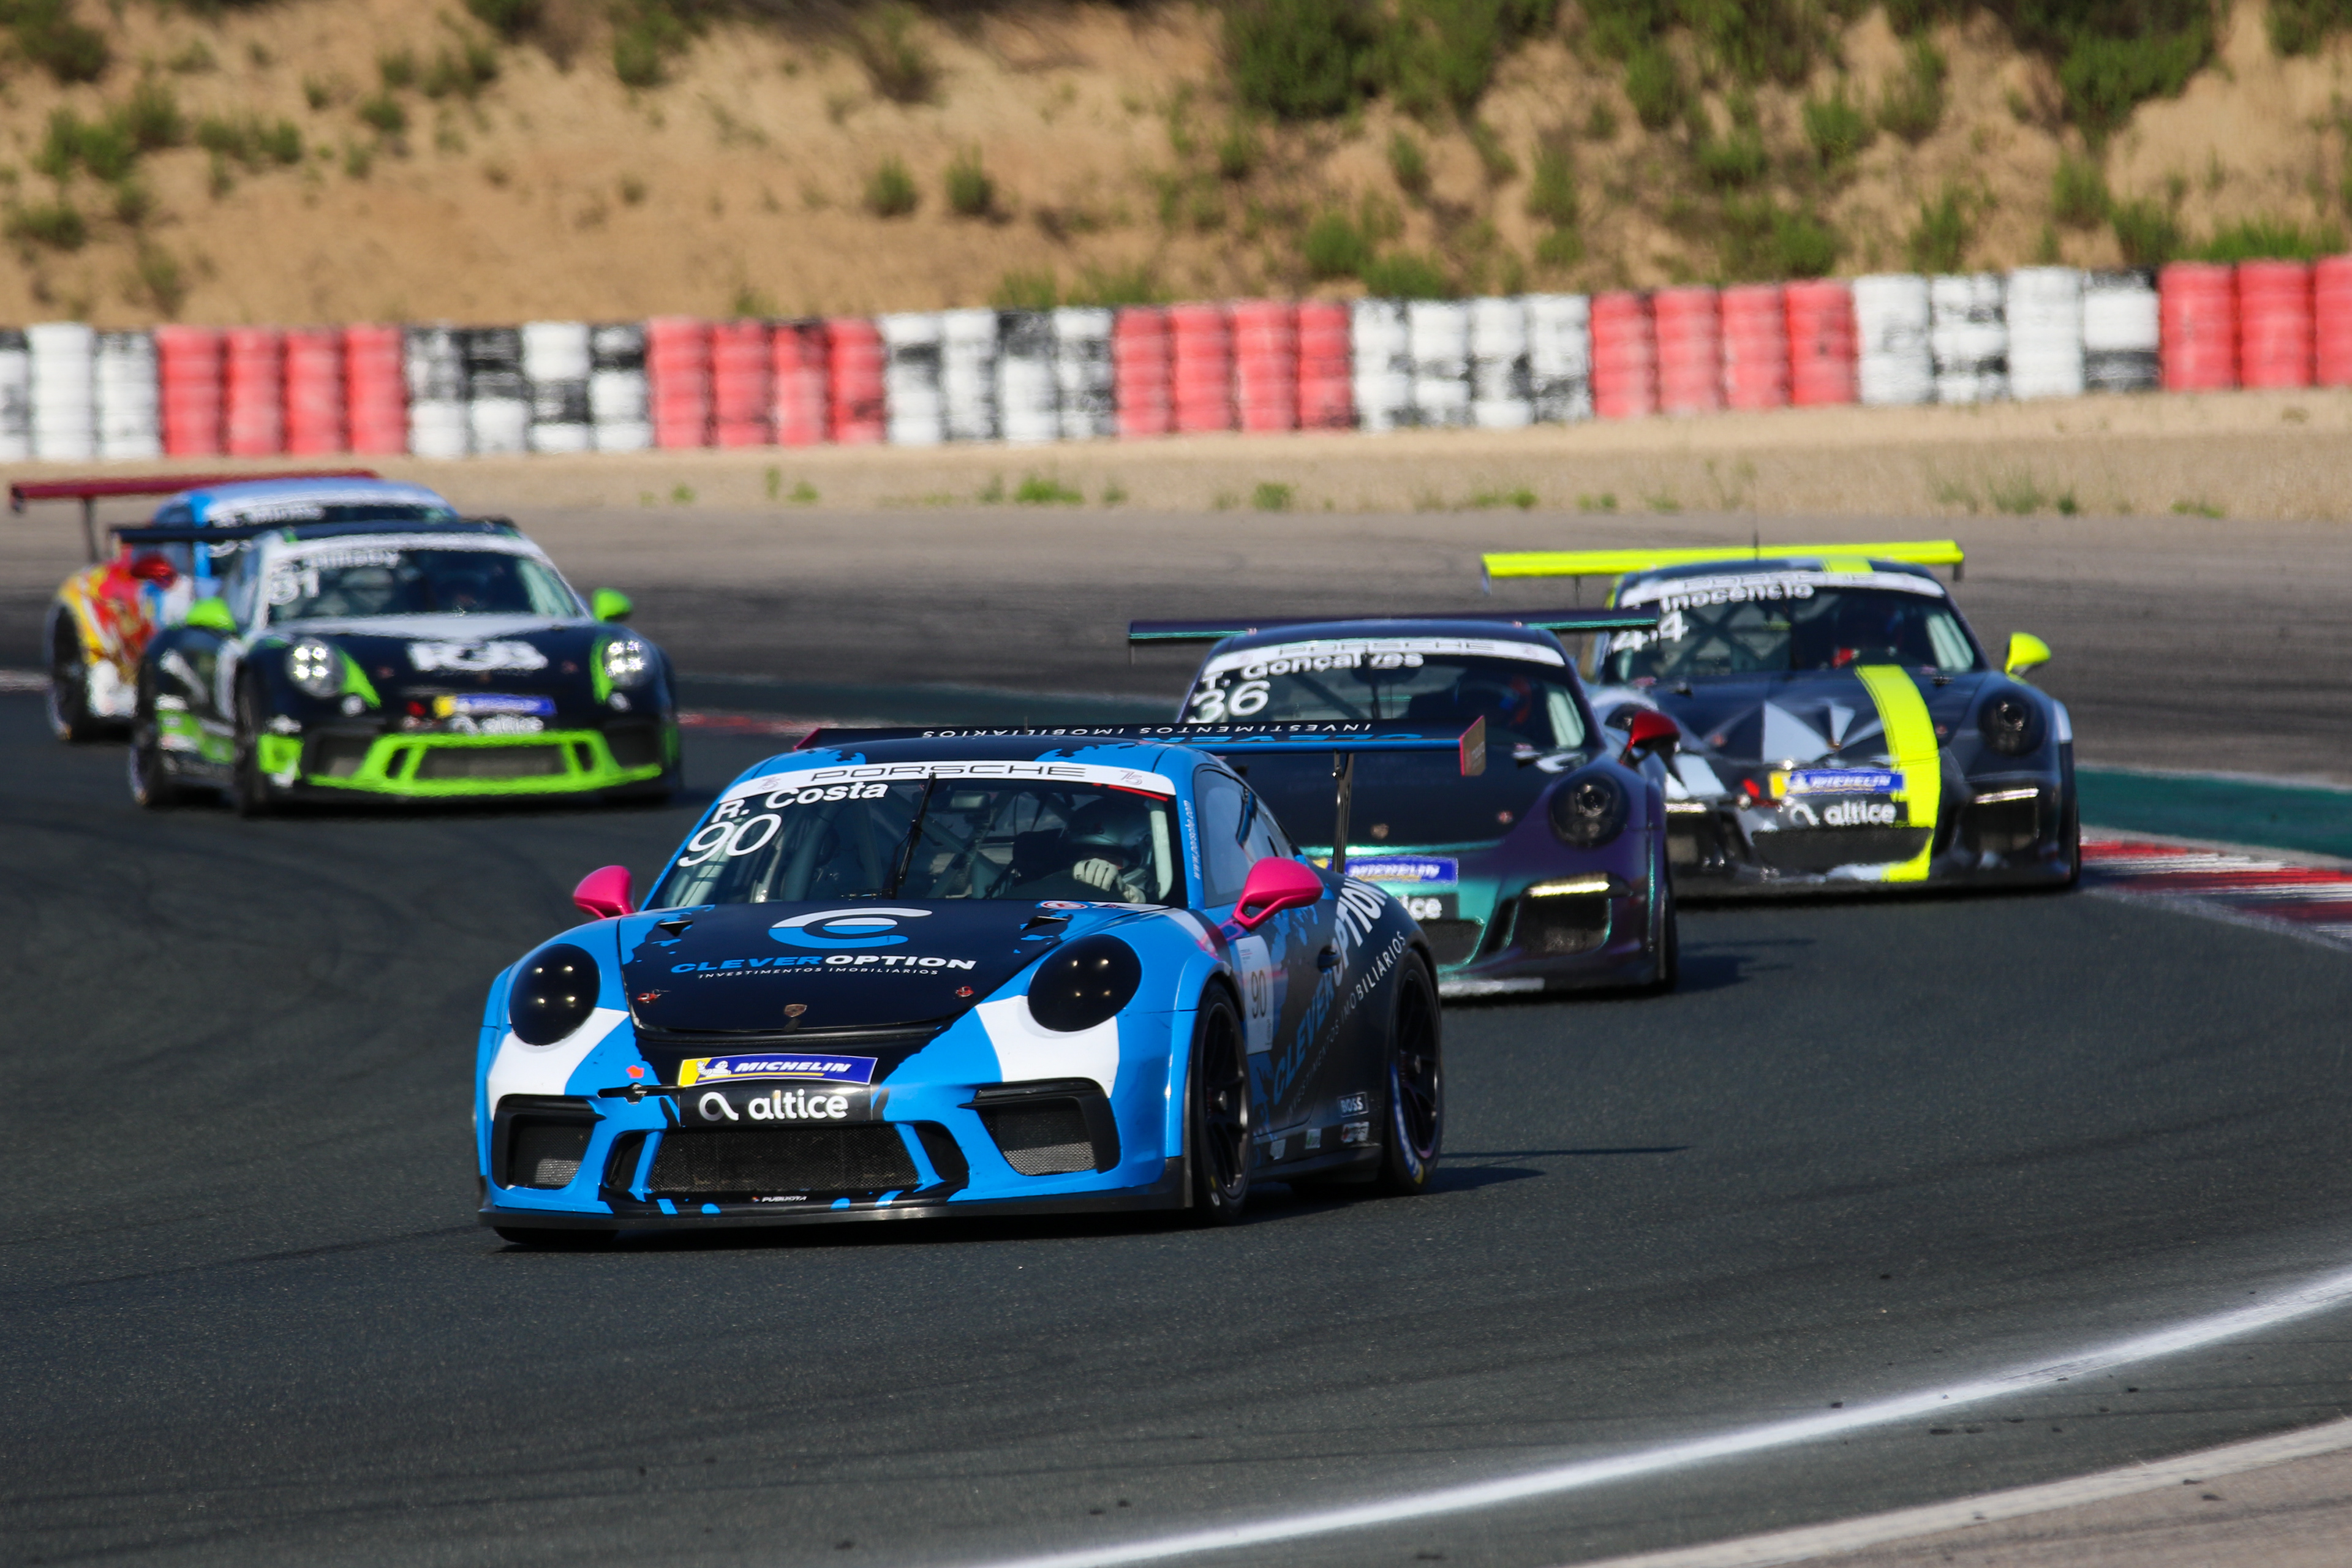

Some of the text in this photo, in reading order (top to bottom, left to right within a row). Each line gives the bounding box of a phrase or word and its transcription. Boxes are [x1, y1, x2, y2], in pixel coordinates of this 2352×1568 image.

[1201, 671, 1231, 690] T.
[1188, 680, 1271, 724] 36
[1139, 723, 1371, 734] INVESTIMENTOS
[811, 764, 1087, 782] PORSCHE
[1810, 775, 1892, 788] MICHELIN
[712, 782, 889, 824] R. Costa
[1823, 799, 1897, 827] altice
[677, 813, 782, 868] 90
[1396, 892, 1442, 921] ice
[698, 967, 823, 979] INVESTIMENTOS
[1251, 969, 1267, 1019] 90
[734, 1061, 852, 1073] MICHELIN
[748, 1088, 849, 1120] altice
